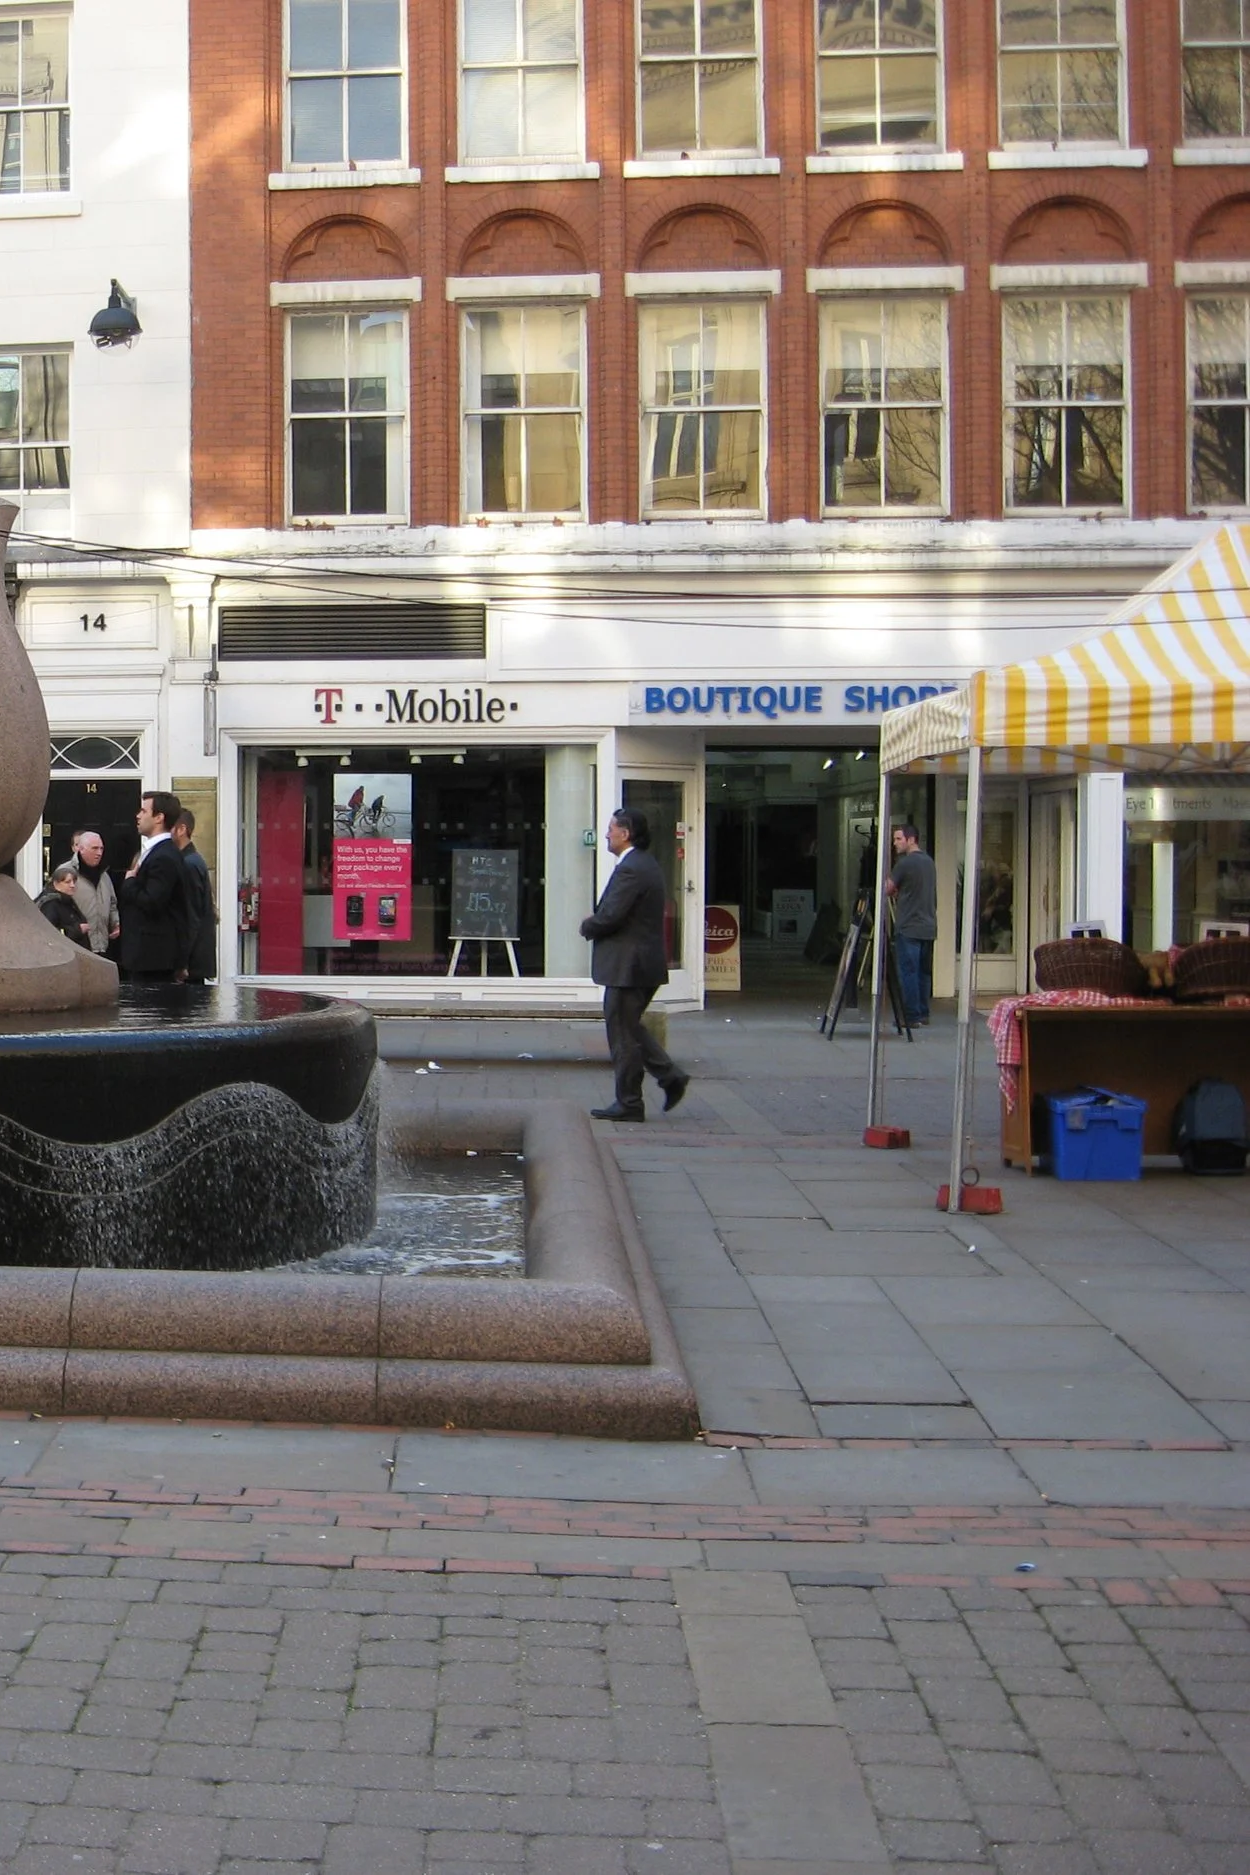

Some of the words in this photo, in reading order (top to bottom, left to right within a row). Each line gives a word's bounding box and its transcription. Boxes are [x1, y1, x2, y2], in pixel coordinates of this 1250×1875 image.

[79, 613, 107, 632] 14
[645, 686, 822, 719] BOUTIQUE
[86, 783, 98, 793] 14
[1126, 797, 1146, 814] Eye
[365, 847, 378, 855] you
[375, 855, 401, 864] change
[353, 864, 383, 872] package
